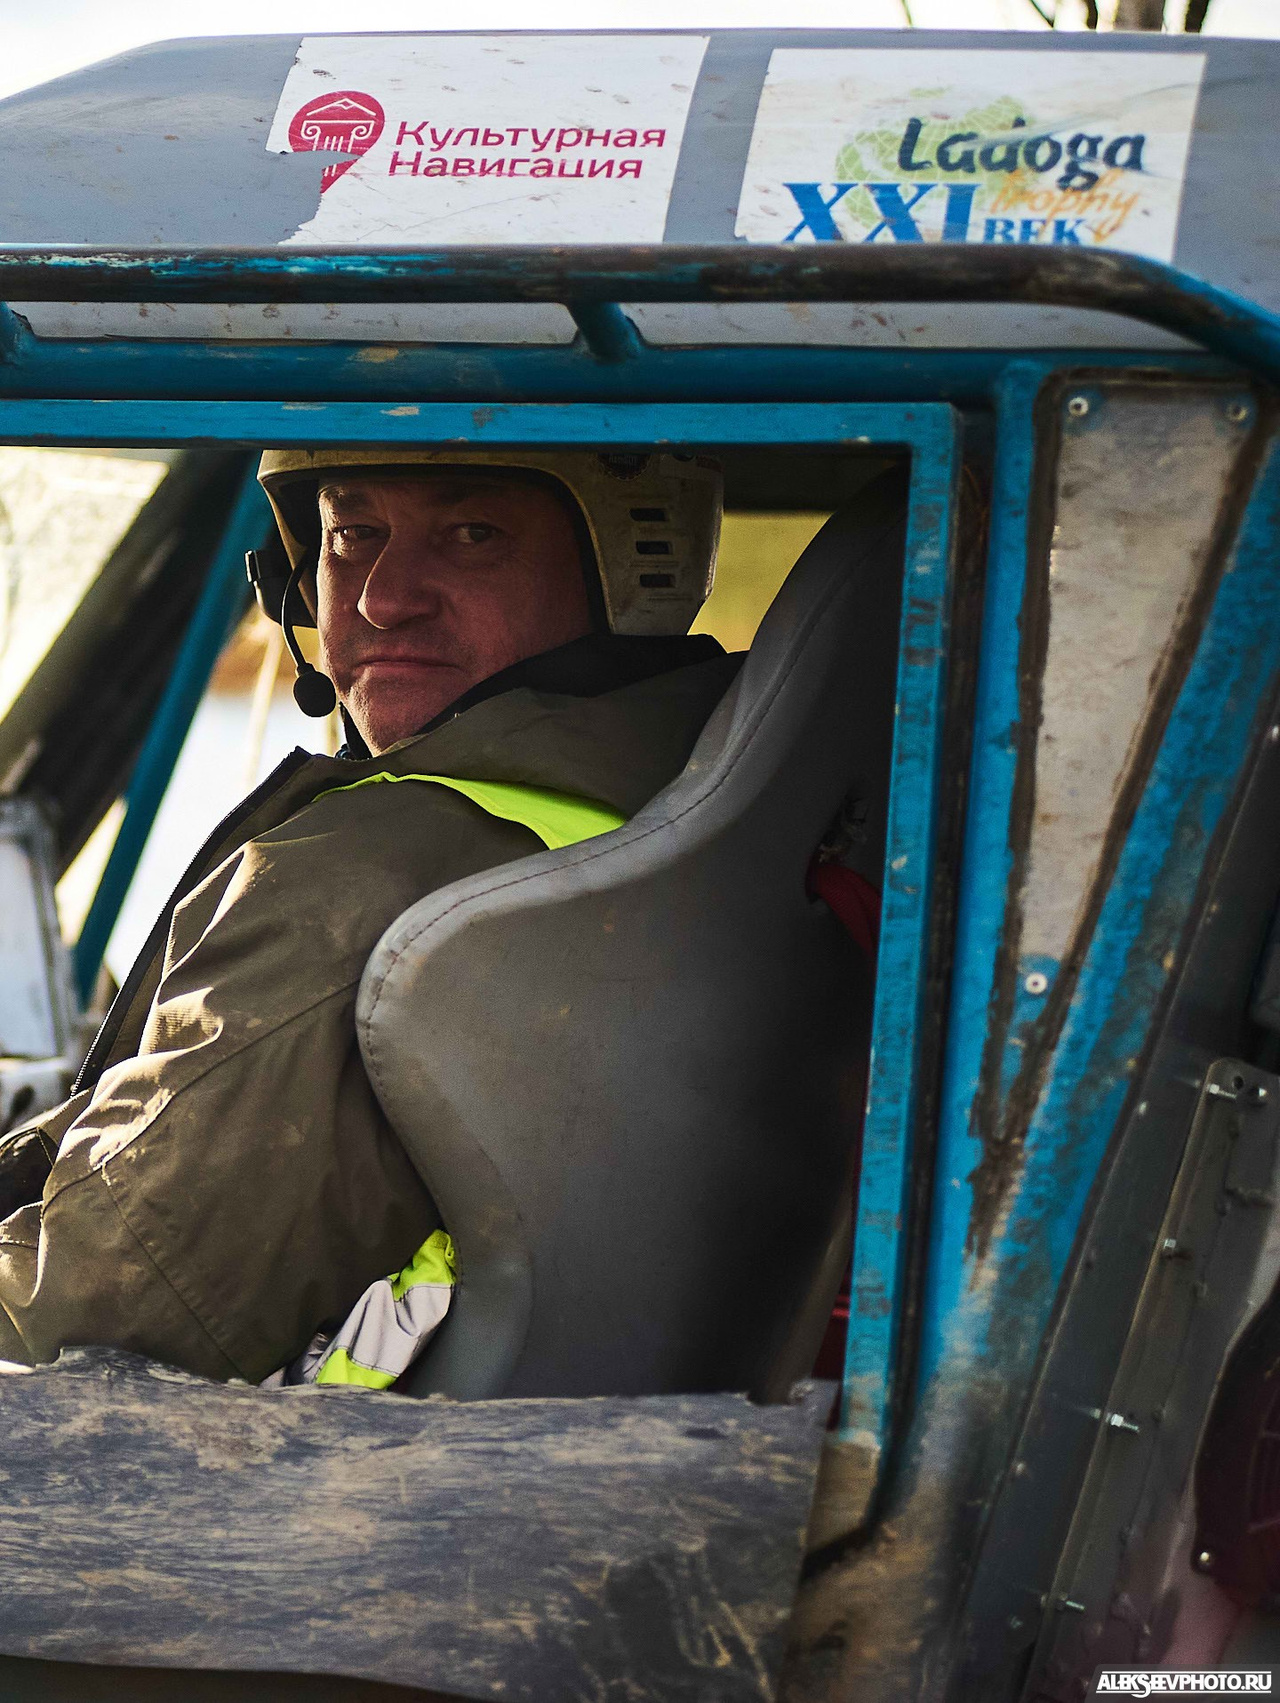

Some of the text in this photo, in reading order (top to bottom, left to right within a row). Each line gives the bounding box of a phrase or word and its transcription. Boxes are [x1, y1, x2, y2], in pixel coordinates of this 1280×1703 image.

[395, 120, 667, 153] Культурная
[388, 150, 644, 179] Навигация
[897, 116, 1146, 192] Ladoga
